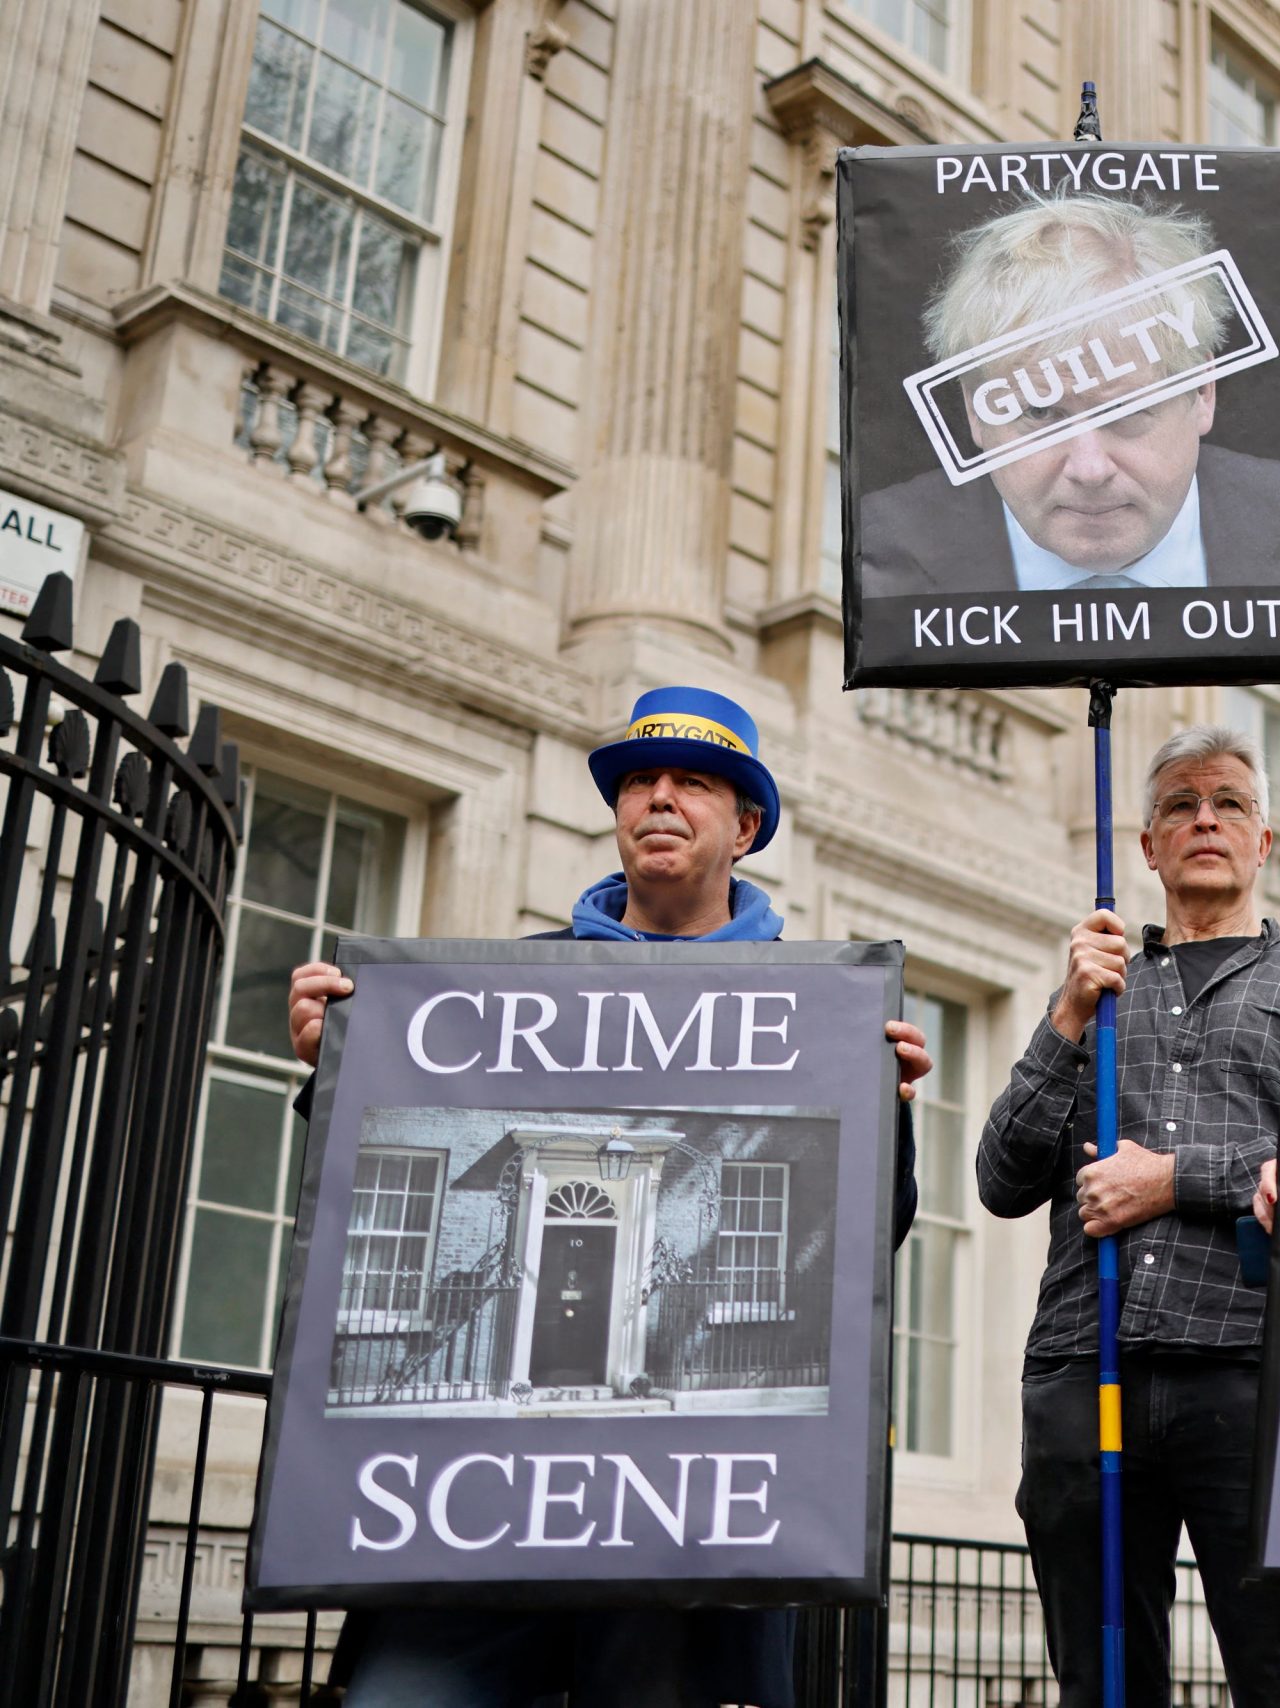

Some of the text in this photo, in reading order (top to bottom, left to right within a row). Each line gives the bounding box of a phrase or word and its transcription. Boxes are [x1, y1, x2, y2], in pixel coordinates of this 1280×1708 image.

[936, 152, 1221, 194] PARTYGATE
[972, 300, 1200, 427] GUILTY
[914, 605, 1022, 648] KICK
[1053, 602, 1150, 642] HIM
[407, 991, 800, 1074] CRIME
[570, 1239, 583, 1248] 10
[352, 1452, 781, 1551] SCENE
